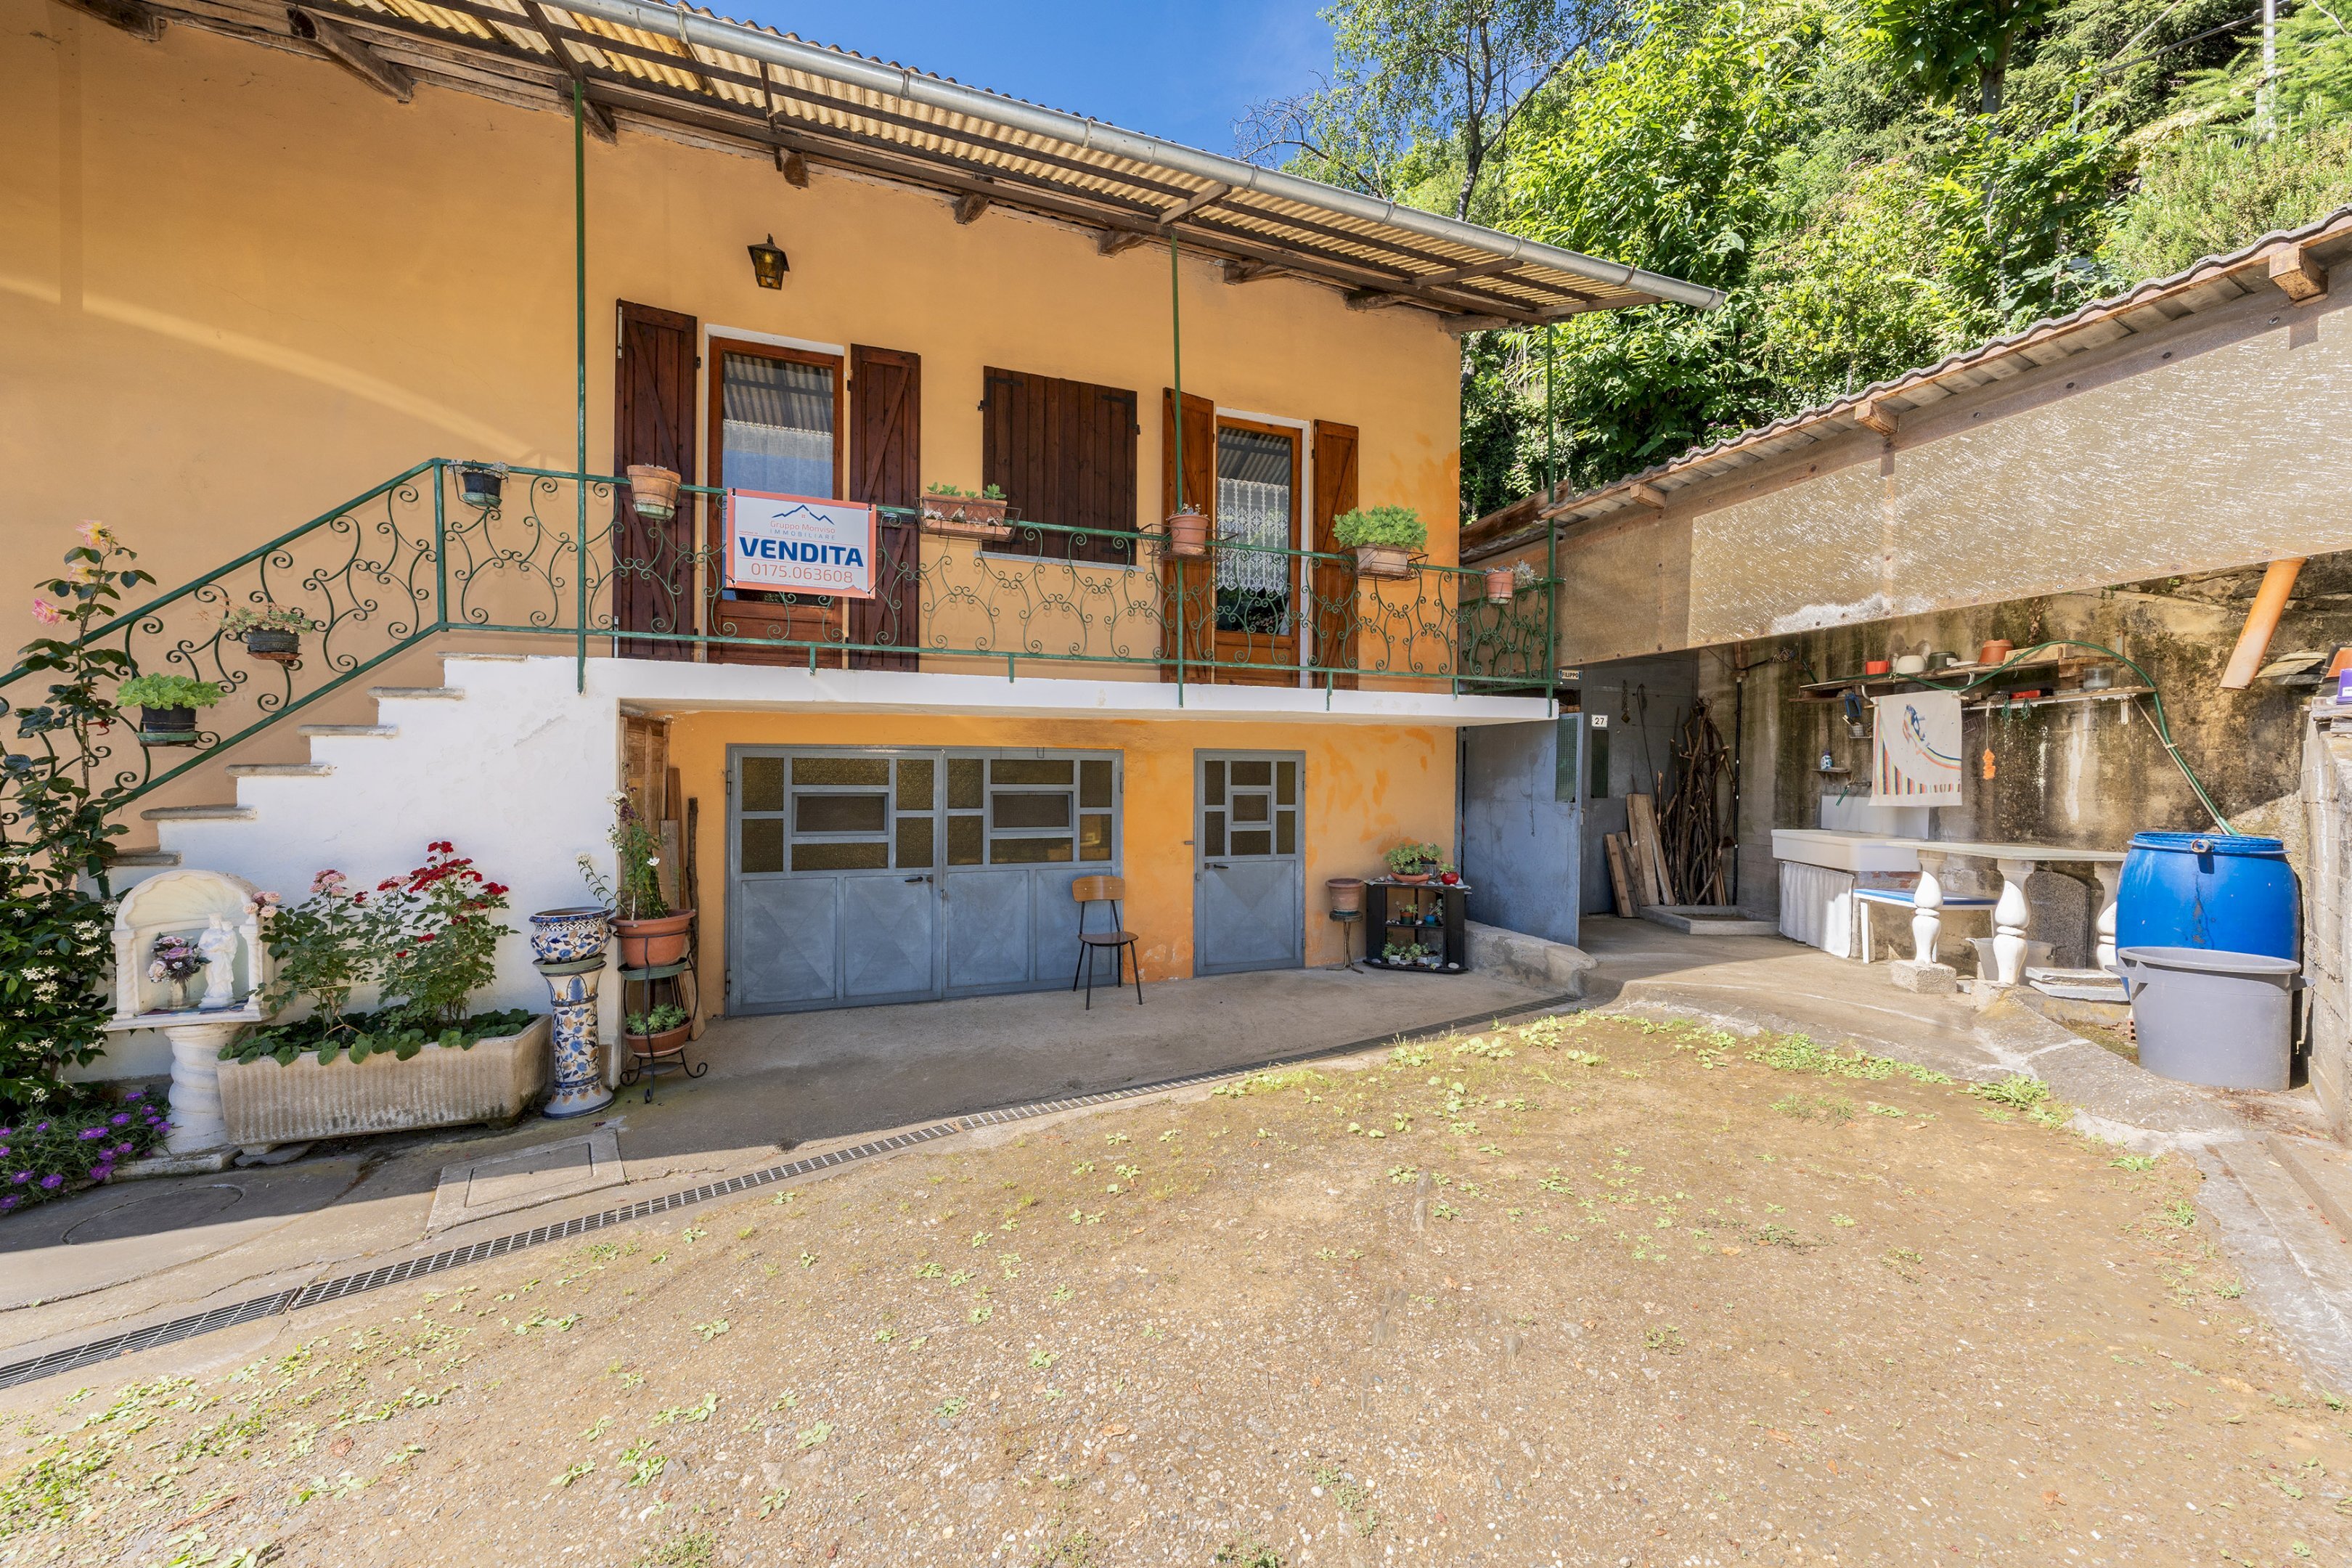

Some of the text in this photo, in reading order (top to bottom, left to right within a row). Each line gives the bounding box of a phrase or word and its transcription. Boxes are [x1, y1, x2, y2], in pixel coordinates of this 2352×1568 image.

[770, 520, 836, 534] Gruppo Monviso
[770, 529, 835, 540] IMMOBILIARE
[739, 536, 864, 567] VENDITA
[751, 563, 853, 583] 0175.063608
